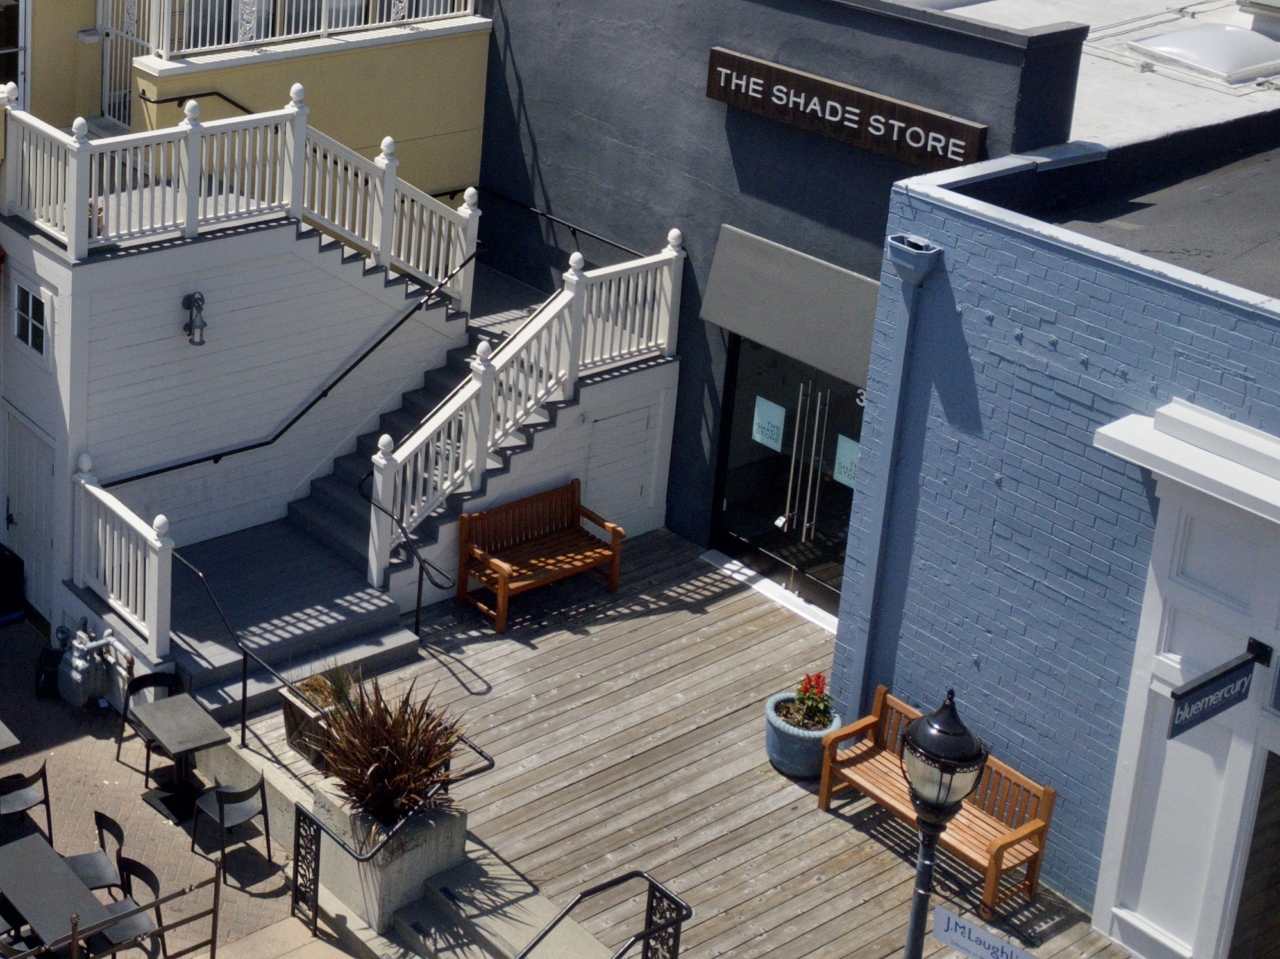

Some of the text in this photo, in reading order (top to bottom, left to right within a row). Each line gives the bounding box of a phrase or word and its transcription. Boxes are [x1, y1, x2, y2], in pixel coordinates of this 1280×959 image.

[716, 66, 967, 162] THE SHADE STORE
[767, 421, 780, 431] THE
[1174, 674, 1252, 725] bluemercury
